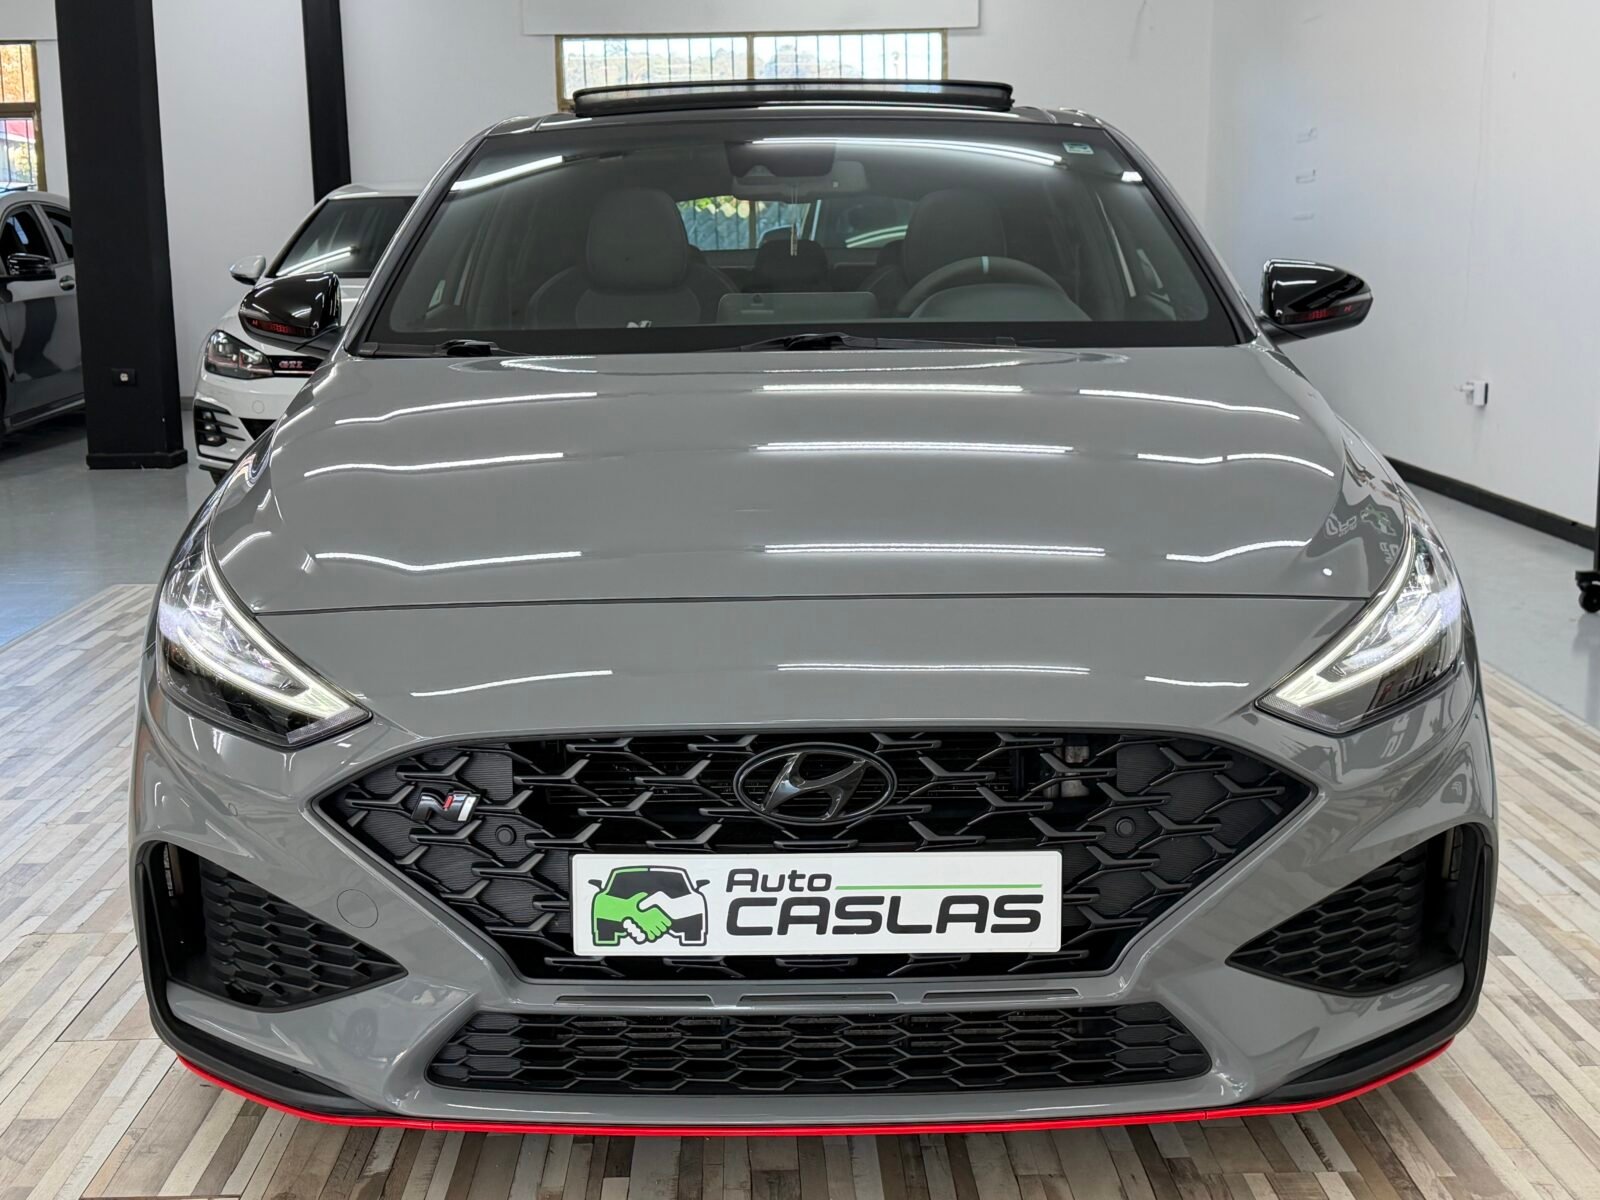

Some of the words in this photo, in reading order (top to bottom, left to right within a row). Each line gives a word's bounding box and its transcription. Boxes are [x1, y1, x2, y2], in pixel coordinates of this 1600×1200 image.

[279, 360, 303, 369] GTI
[725, 868, 832, 893] Auto
[726, 894, 1044, 936] CASLAS
